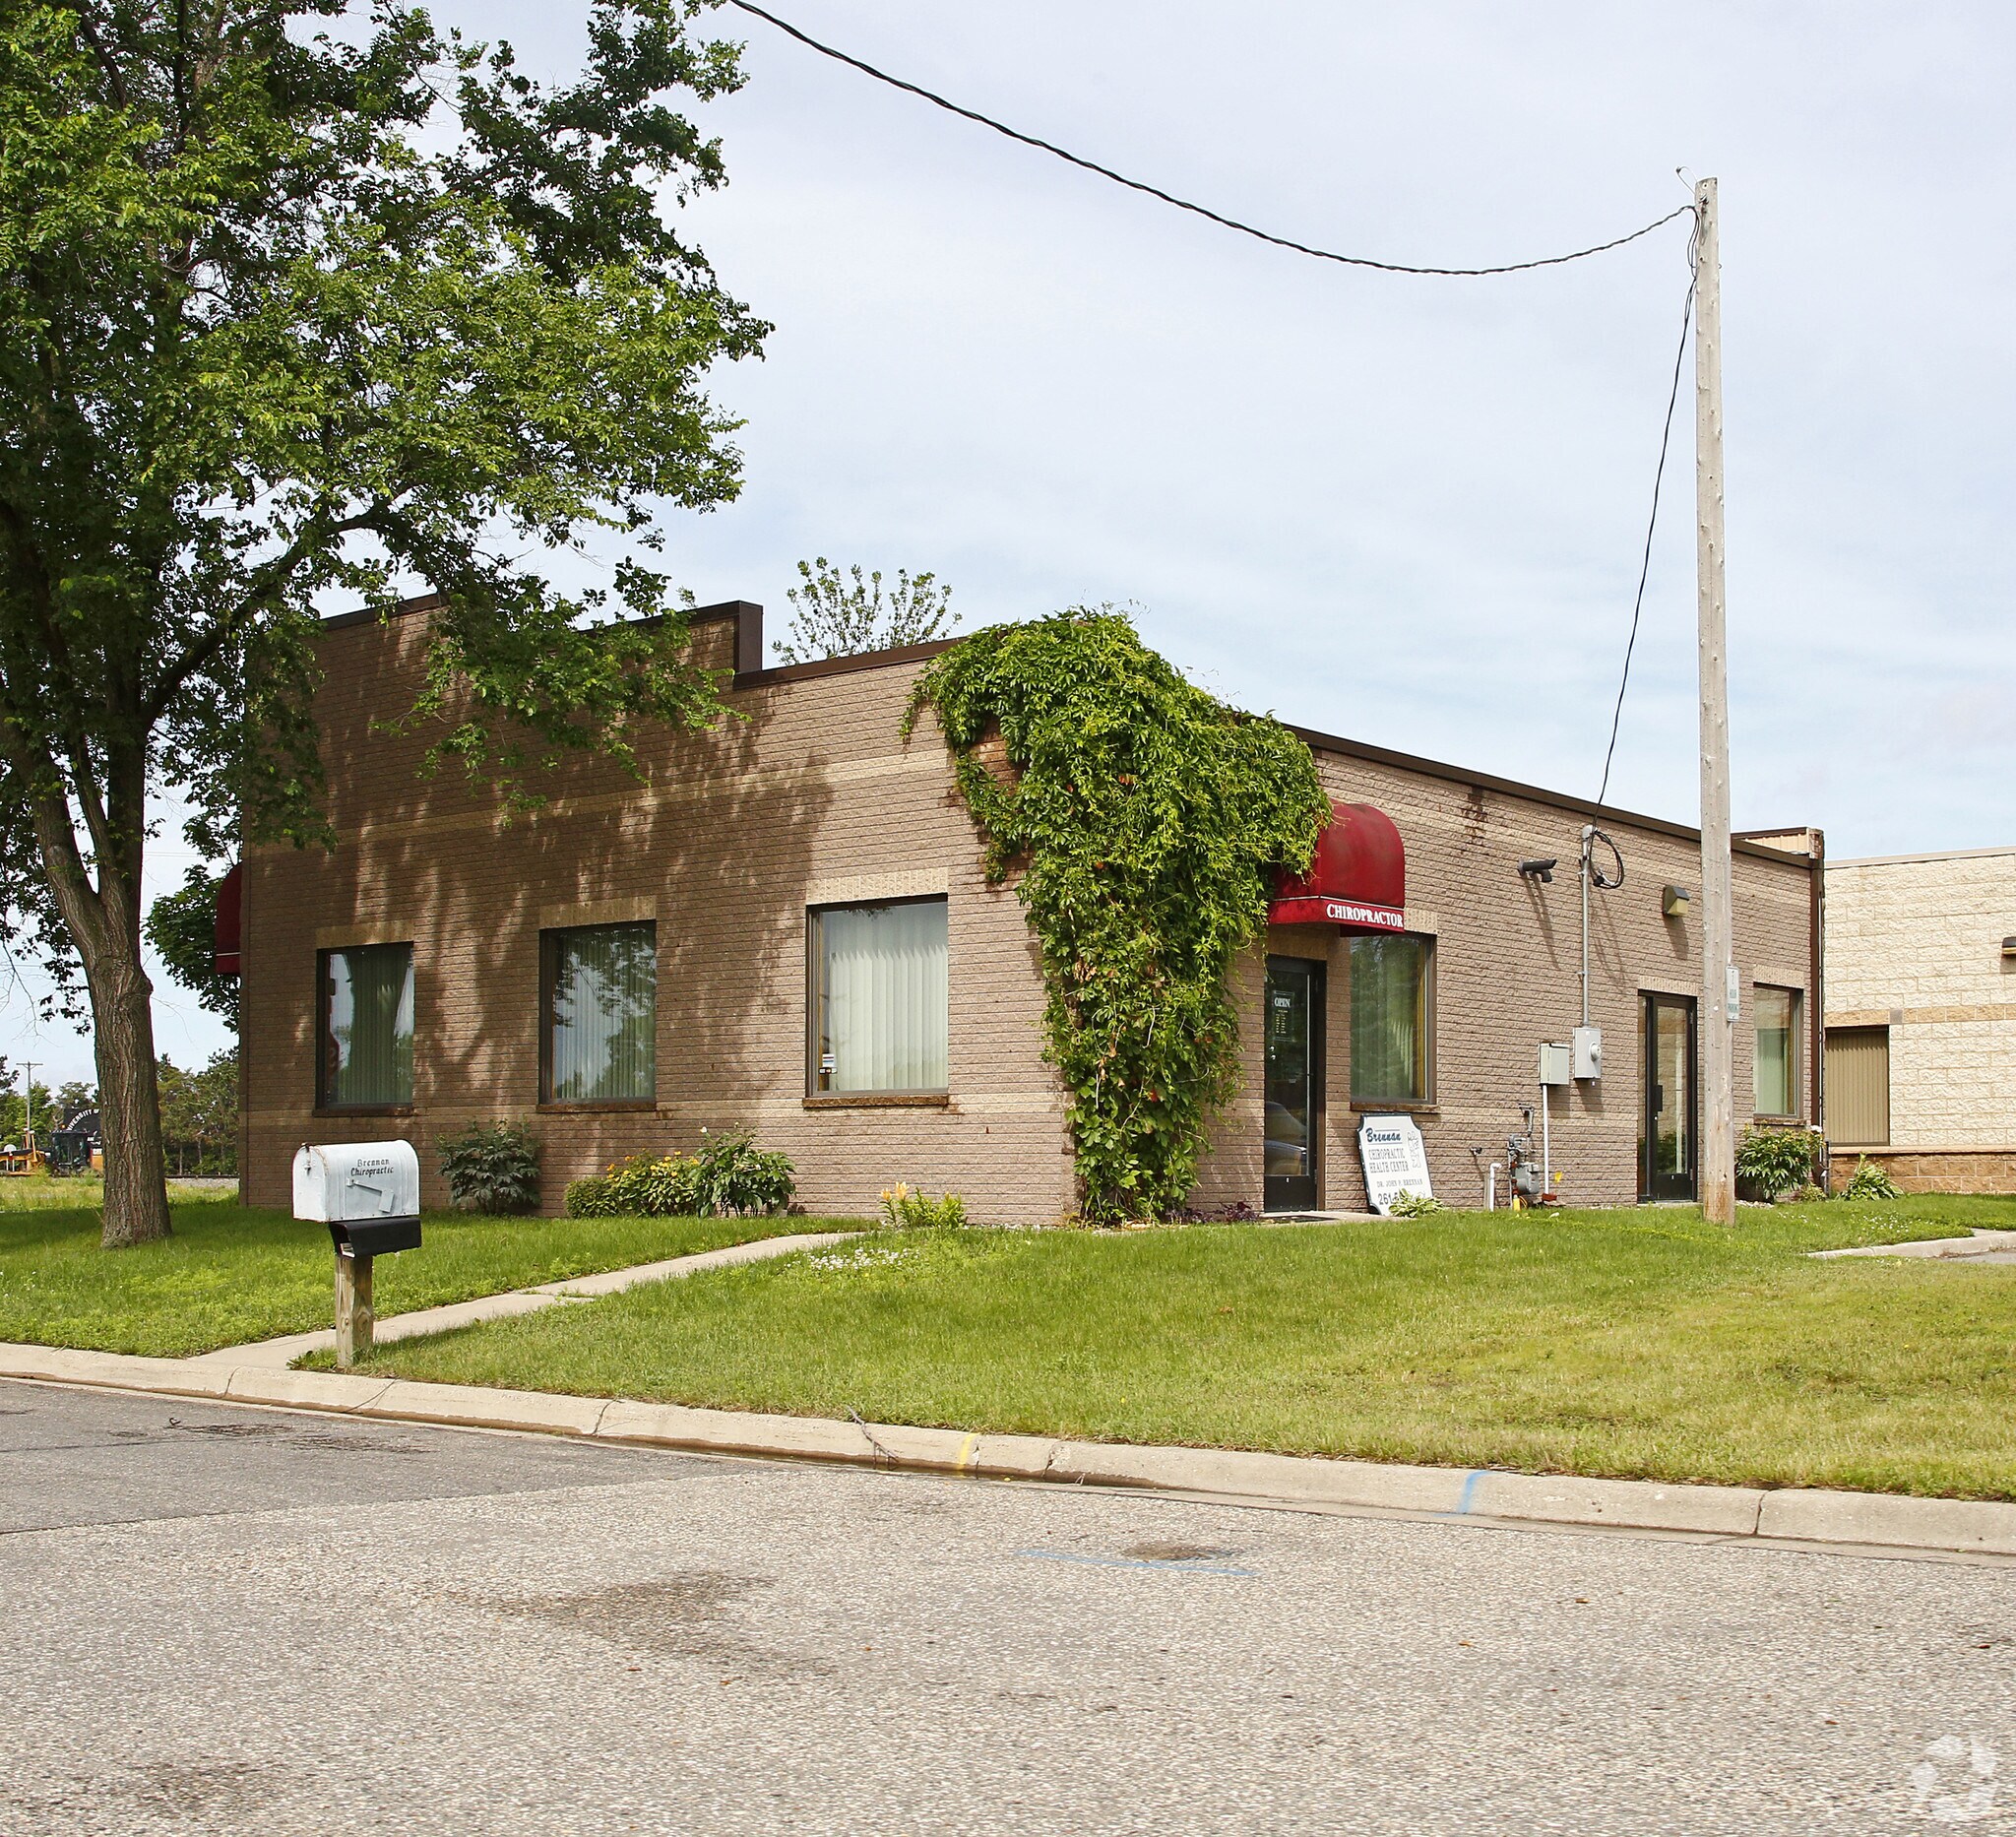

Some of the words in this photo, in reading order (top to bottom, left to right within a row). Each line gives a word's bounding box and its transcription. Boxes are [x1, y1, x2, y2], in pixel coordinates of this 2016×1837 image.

[1326, 903, 1404, 928] CHIROPRACTOR
[1274, 997, 1291, 1008] OPEN
[1365, 1127, 1401, 1142] Brennan
[1368, 1148, 1405, 1160] CHIROPRACTIC
[350, 1167, 394, 1177] Chiropractic
[1368, 1162, 1390, 1173] HEALTH
[1390, 1161, 1409, 1172] CENTER
